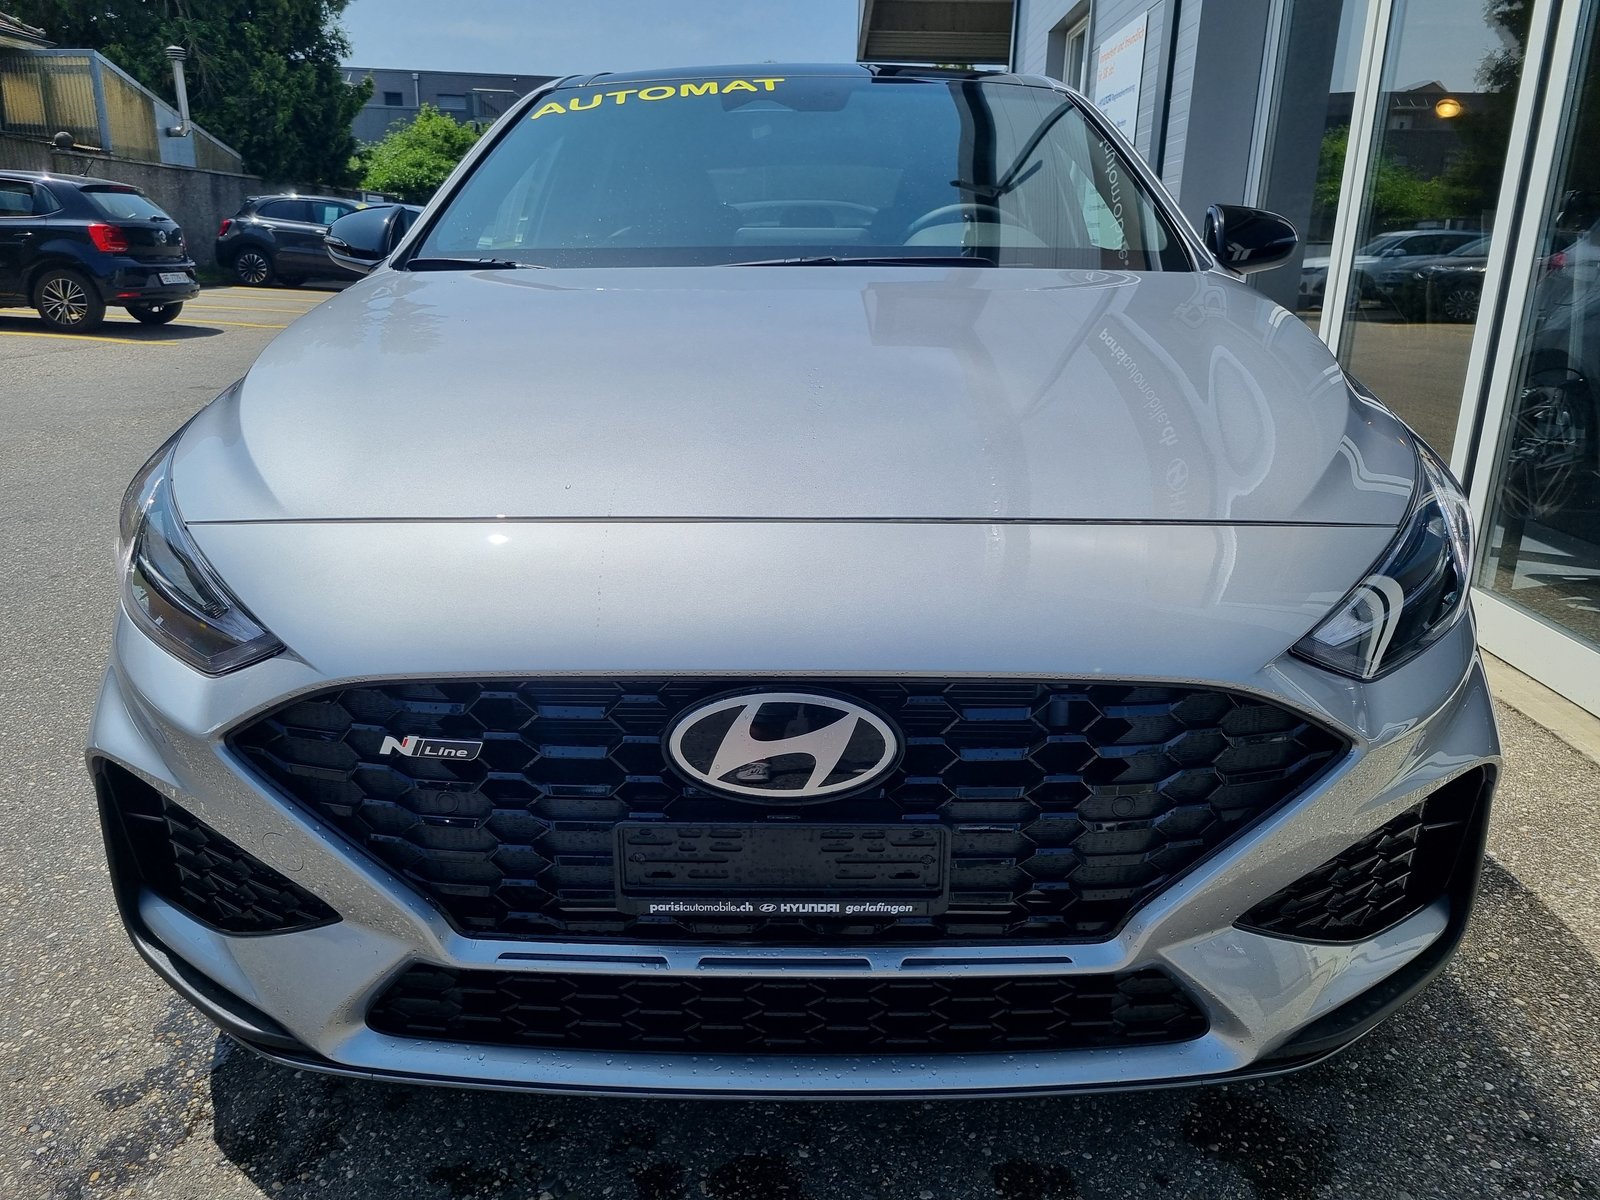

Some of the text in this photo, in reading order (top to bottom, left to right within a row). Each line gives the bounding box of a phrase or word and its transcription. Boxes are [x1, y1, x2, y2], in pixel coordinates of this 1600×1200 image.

[531, 78, 785, 119] AUTOMAT
[379, 735, 468, 757] N Line
[649, 901, 913, 914] parisiautomobile.ch HYUNDAI gerlafingen
